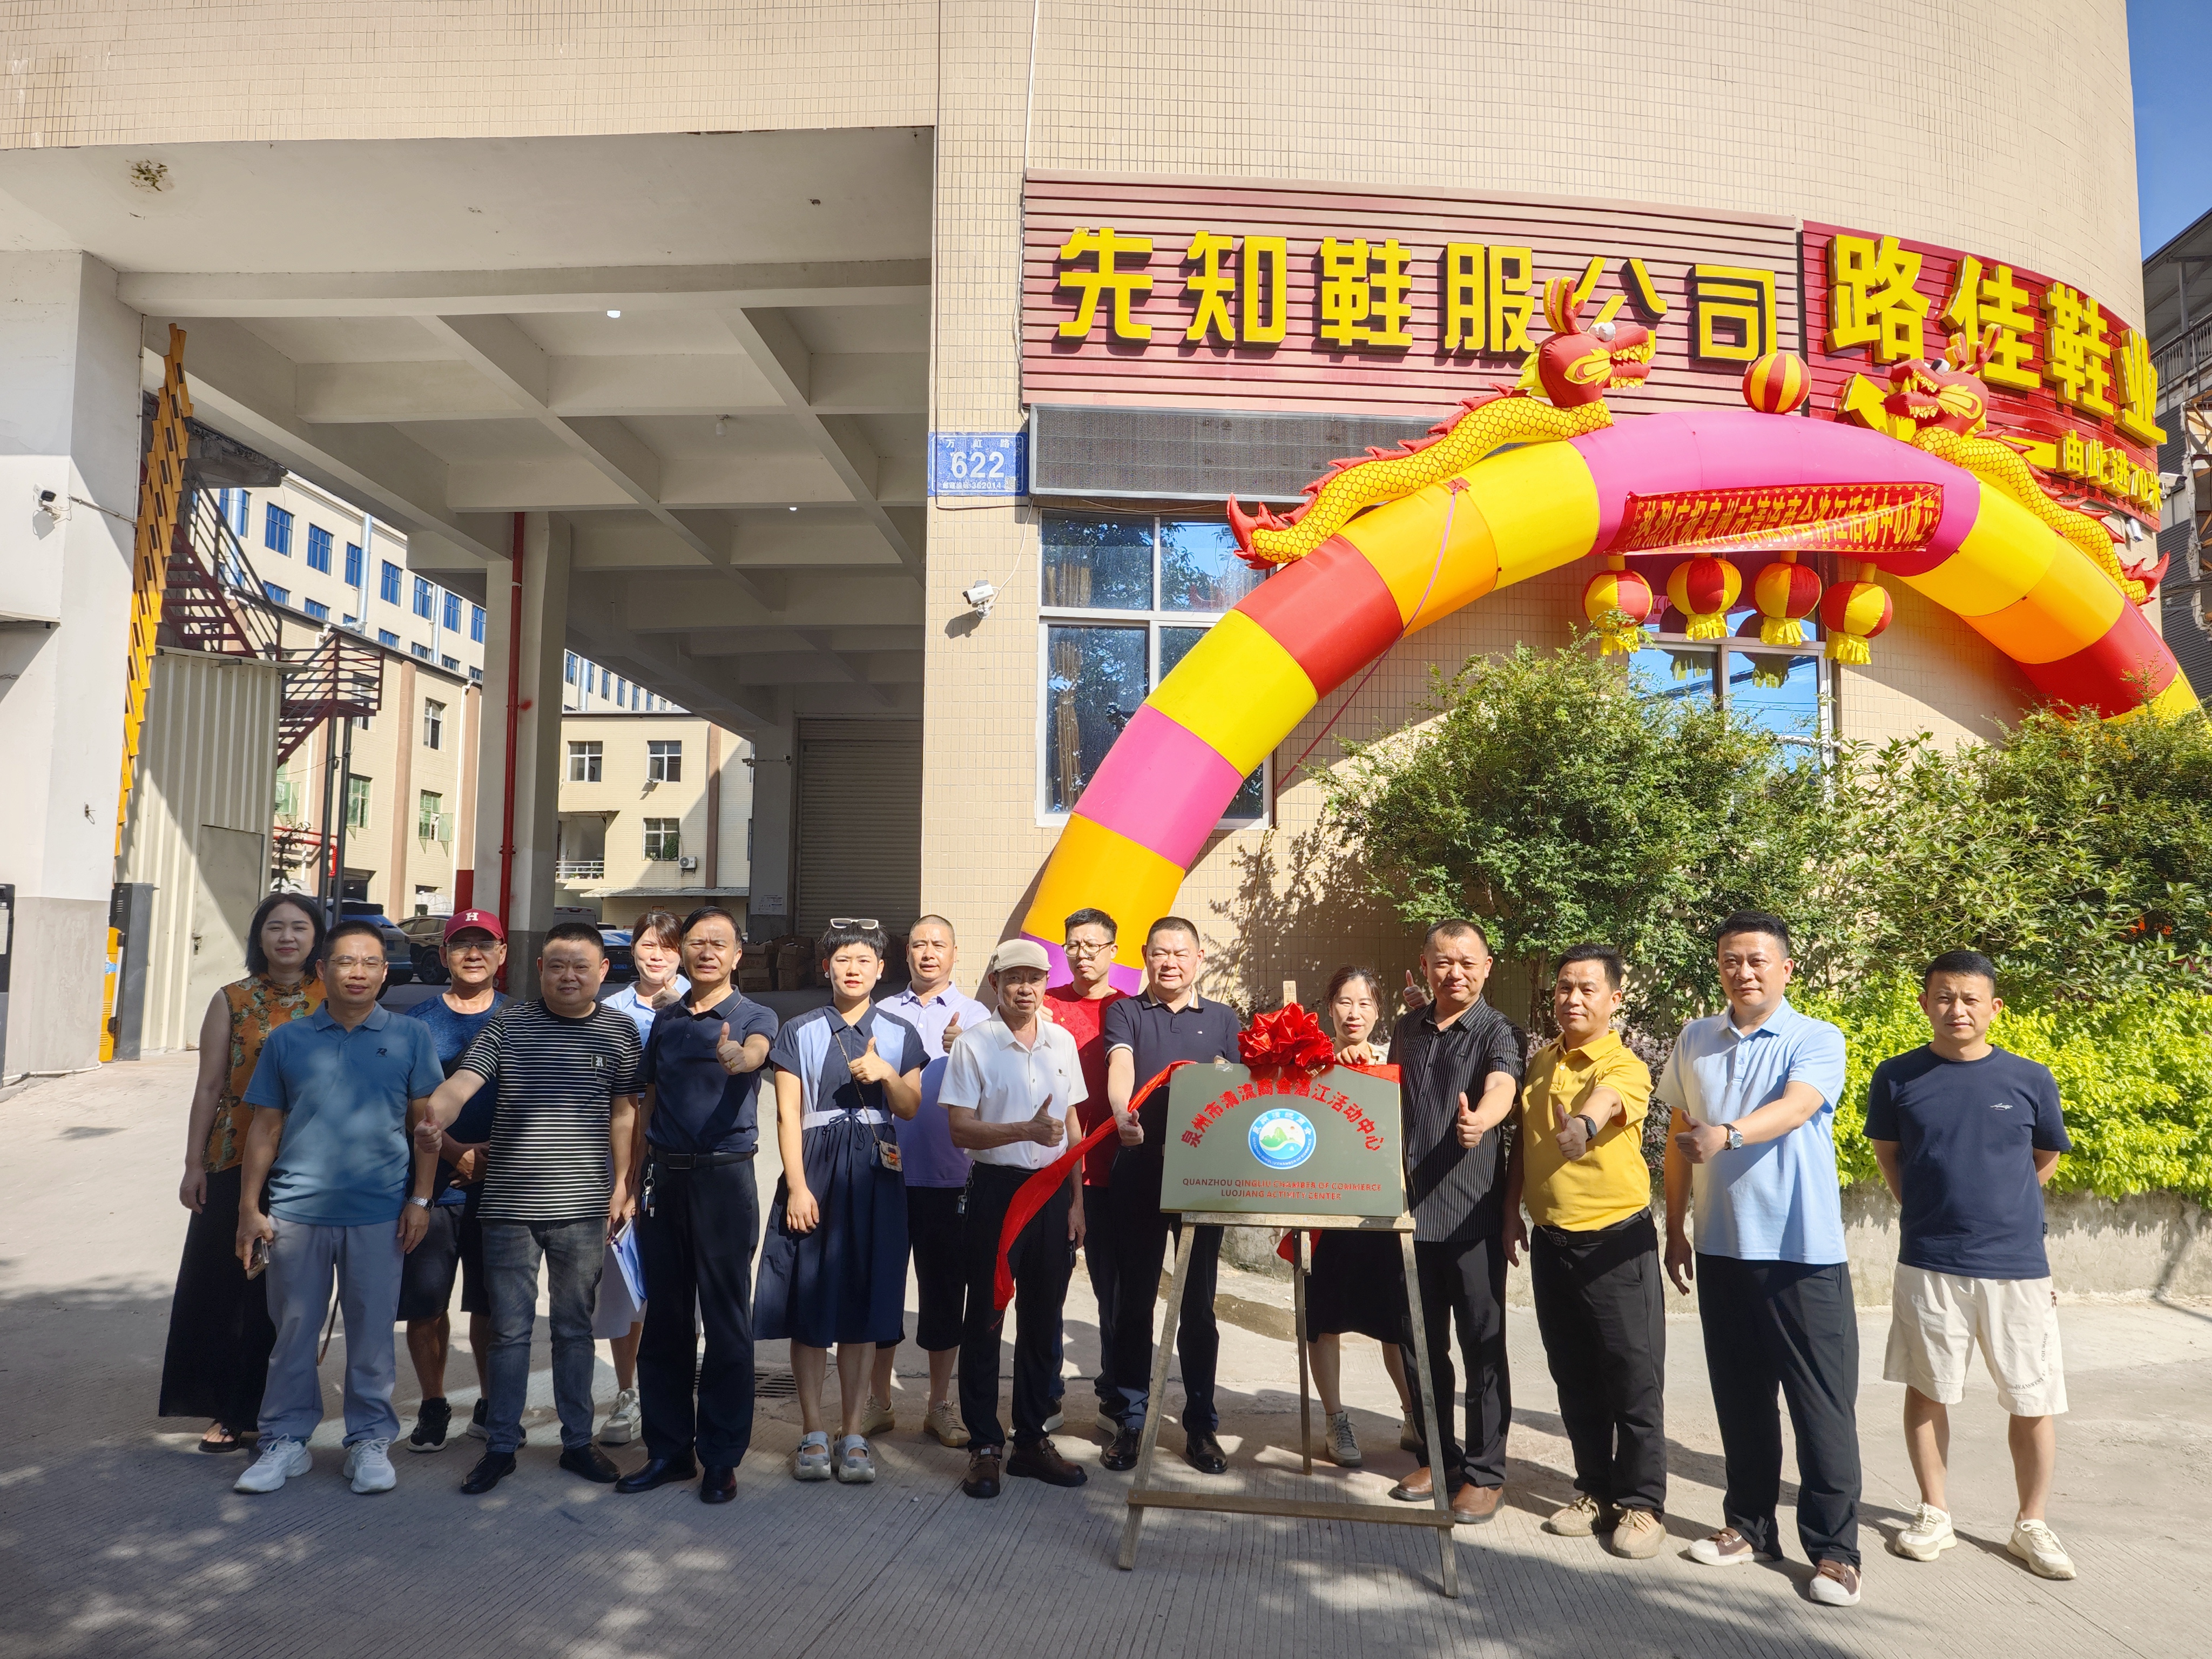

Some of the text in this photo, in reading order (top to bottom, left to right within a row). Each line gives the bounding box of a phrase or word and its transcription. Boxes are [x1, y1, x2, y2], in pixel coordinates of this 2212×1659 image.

[1058, 227, 1777, 361] 先知鞋服公司
[1826, 233, 2167, 447] 路佳鞋业
[951, 451, 1004, 478] 622
[2055, 429, 2163, 512] 由此进70米
[465, 912, 479, 921] H
[1181, 1077, 1385, 1151] 泉州市清流商会洛江活动中心
[1221, 1189, 1341, 1200] LUOJIANG ACTIVITY CENTER
[1273, 1181, 1316, 1189] CHAMBER
[1331, 1183, 1382, 1191] COMMERCE
